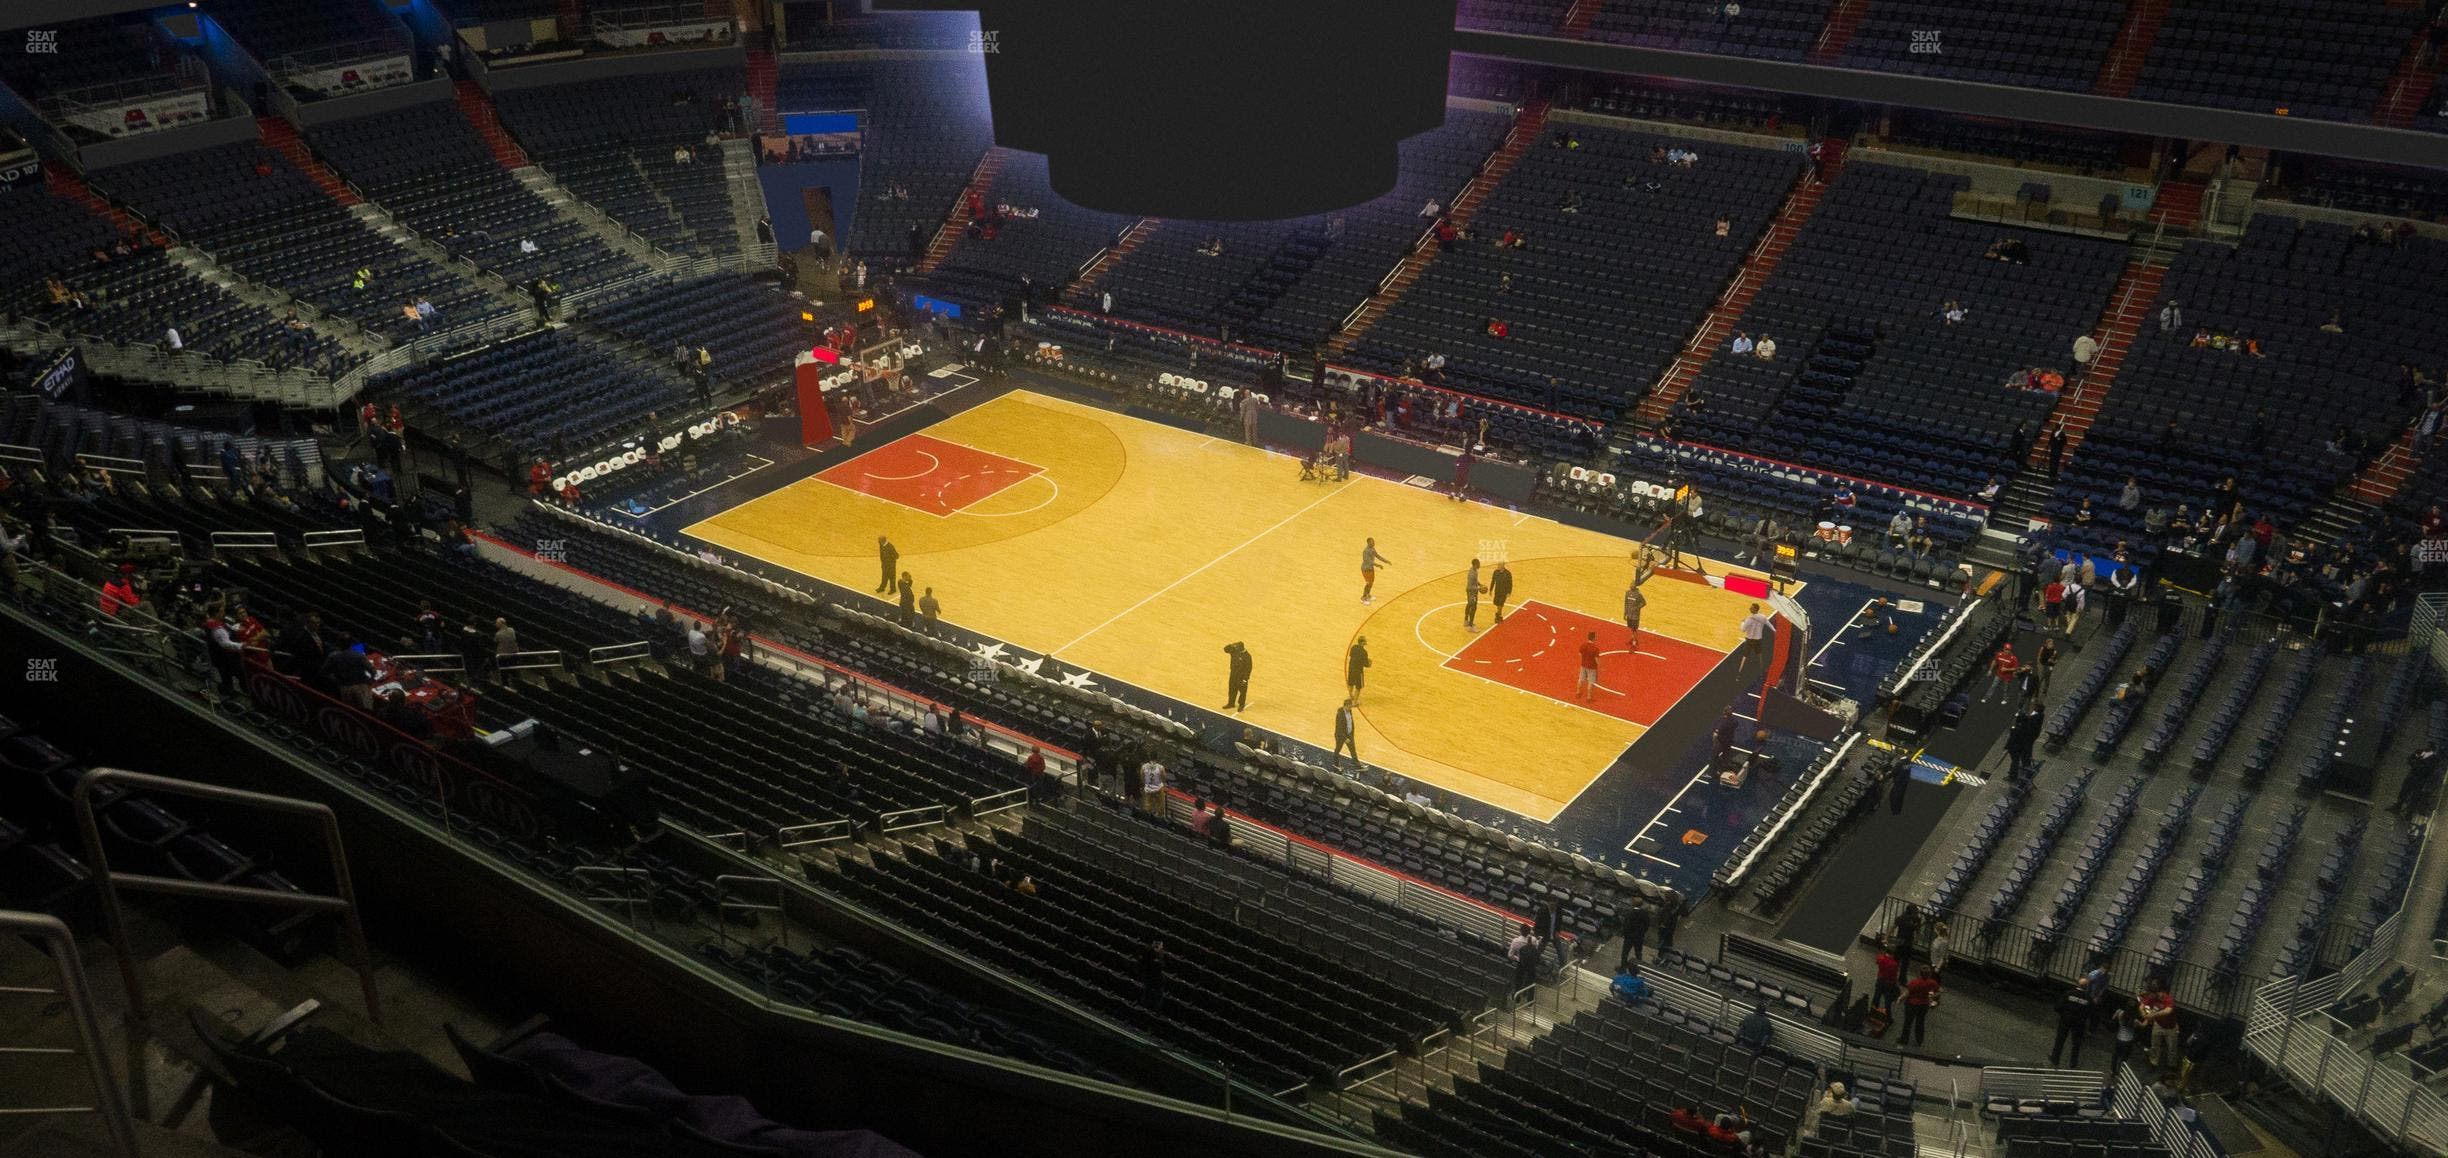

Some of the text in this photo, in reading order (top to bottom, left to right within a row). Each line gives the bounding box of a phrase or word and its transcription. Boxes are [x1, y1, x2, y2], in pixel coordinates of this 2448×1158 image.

[23, 163, 39, 176] 107
[2130, 188, 2148, 199] 121
[328, 712, 370, 752] KIA
